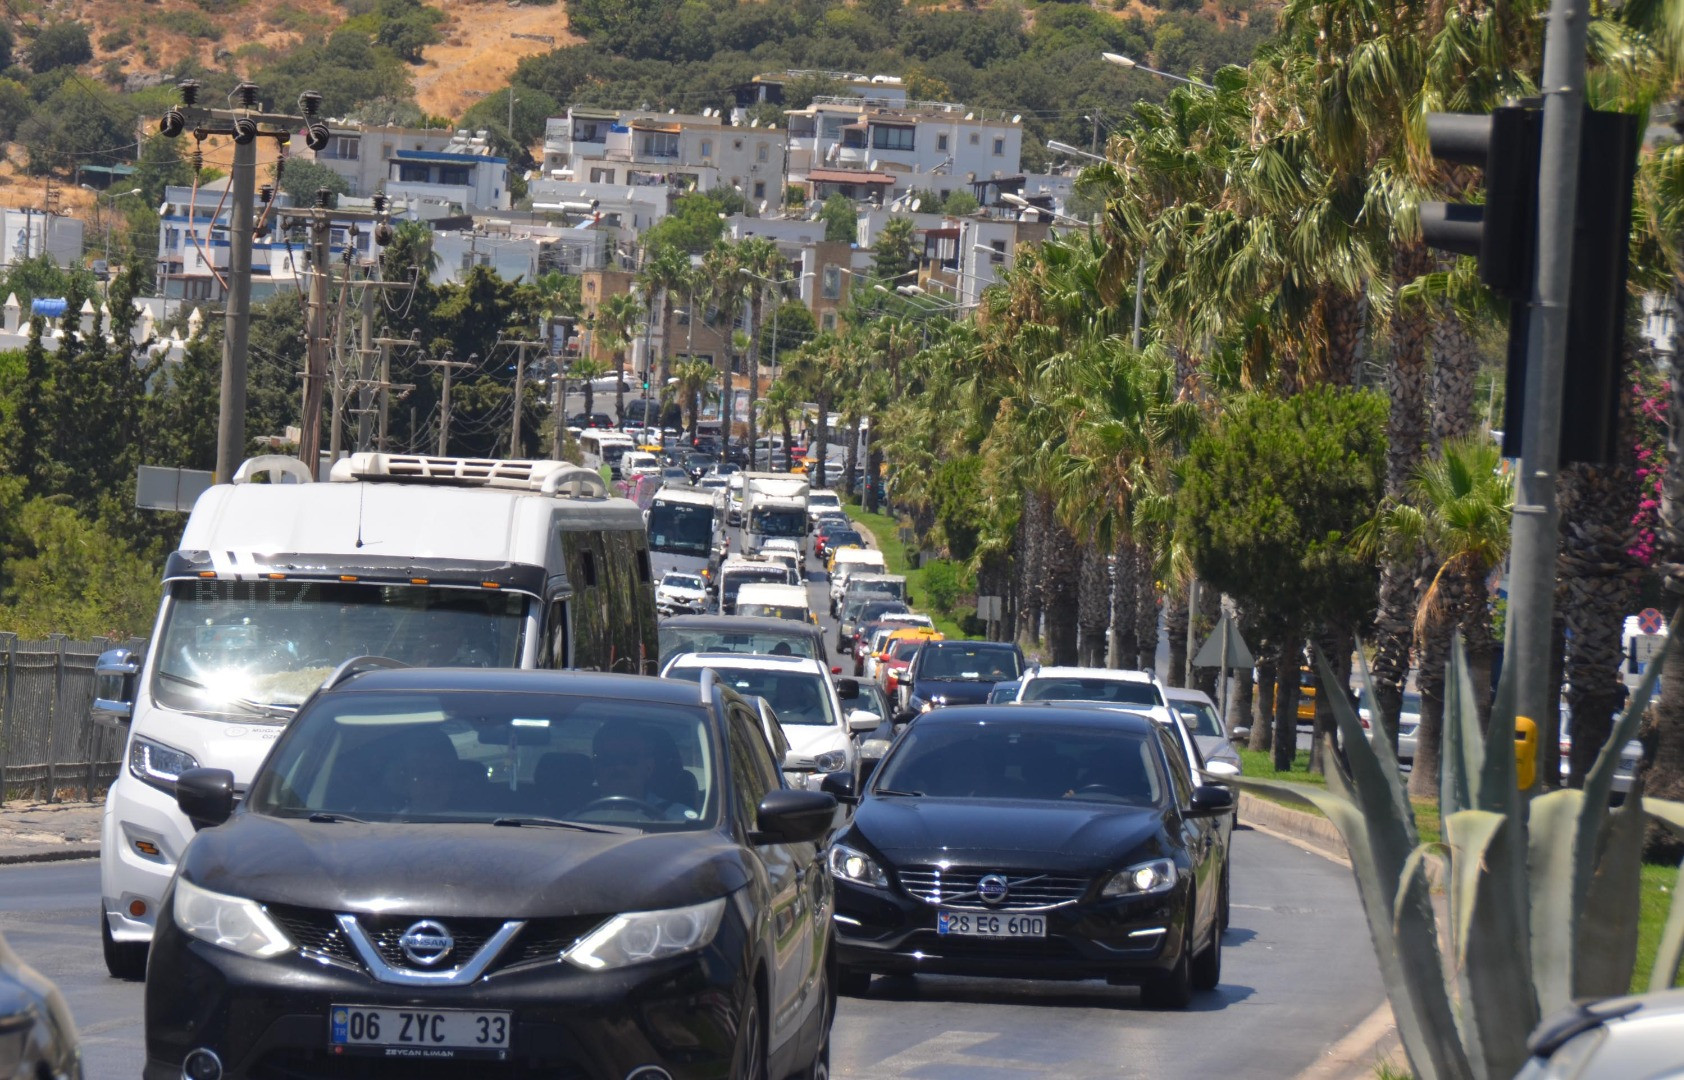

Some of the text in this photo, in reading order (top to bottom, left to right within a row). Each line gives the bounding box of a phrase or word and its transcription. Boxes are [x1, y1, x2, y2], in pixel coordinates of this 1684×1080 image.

[195, 580, 313, 610] BITEZ
[949, 916, 1043, 934] 28 EG 600
[336, 1028, 346, 1037] TR
[350, 1012, 506, 1044] 06 ZYC 33
[385, 1048, 421, 1056] ZEYCAN
